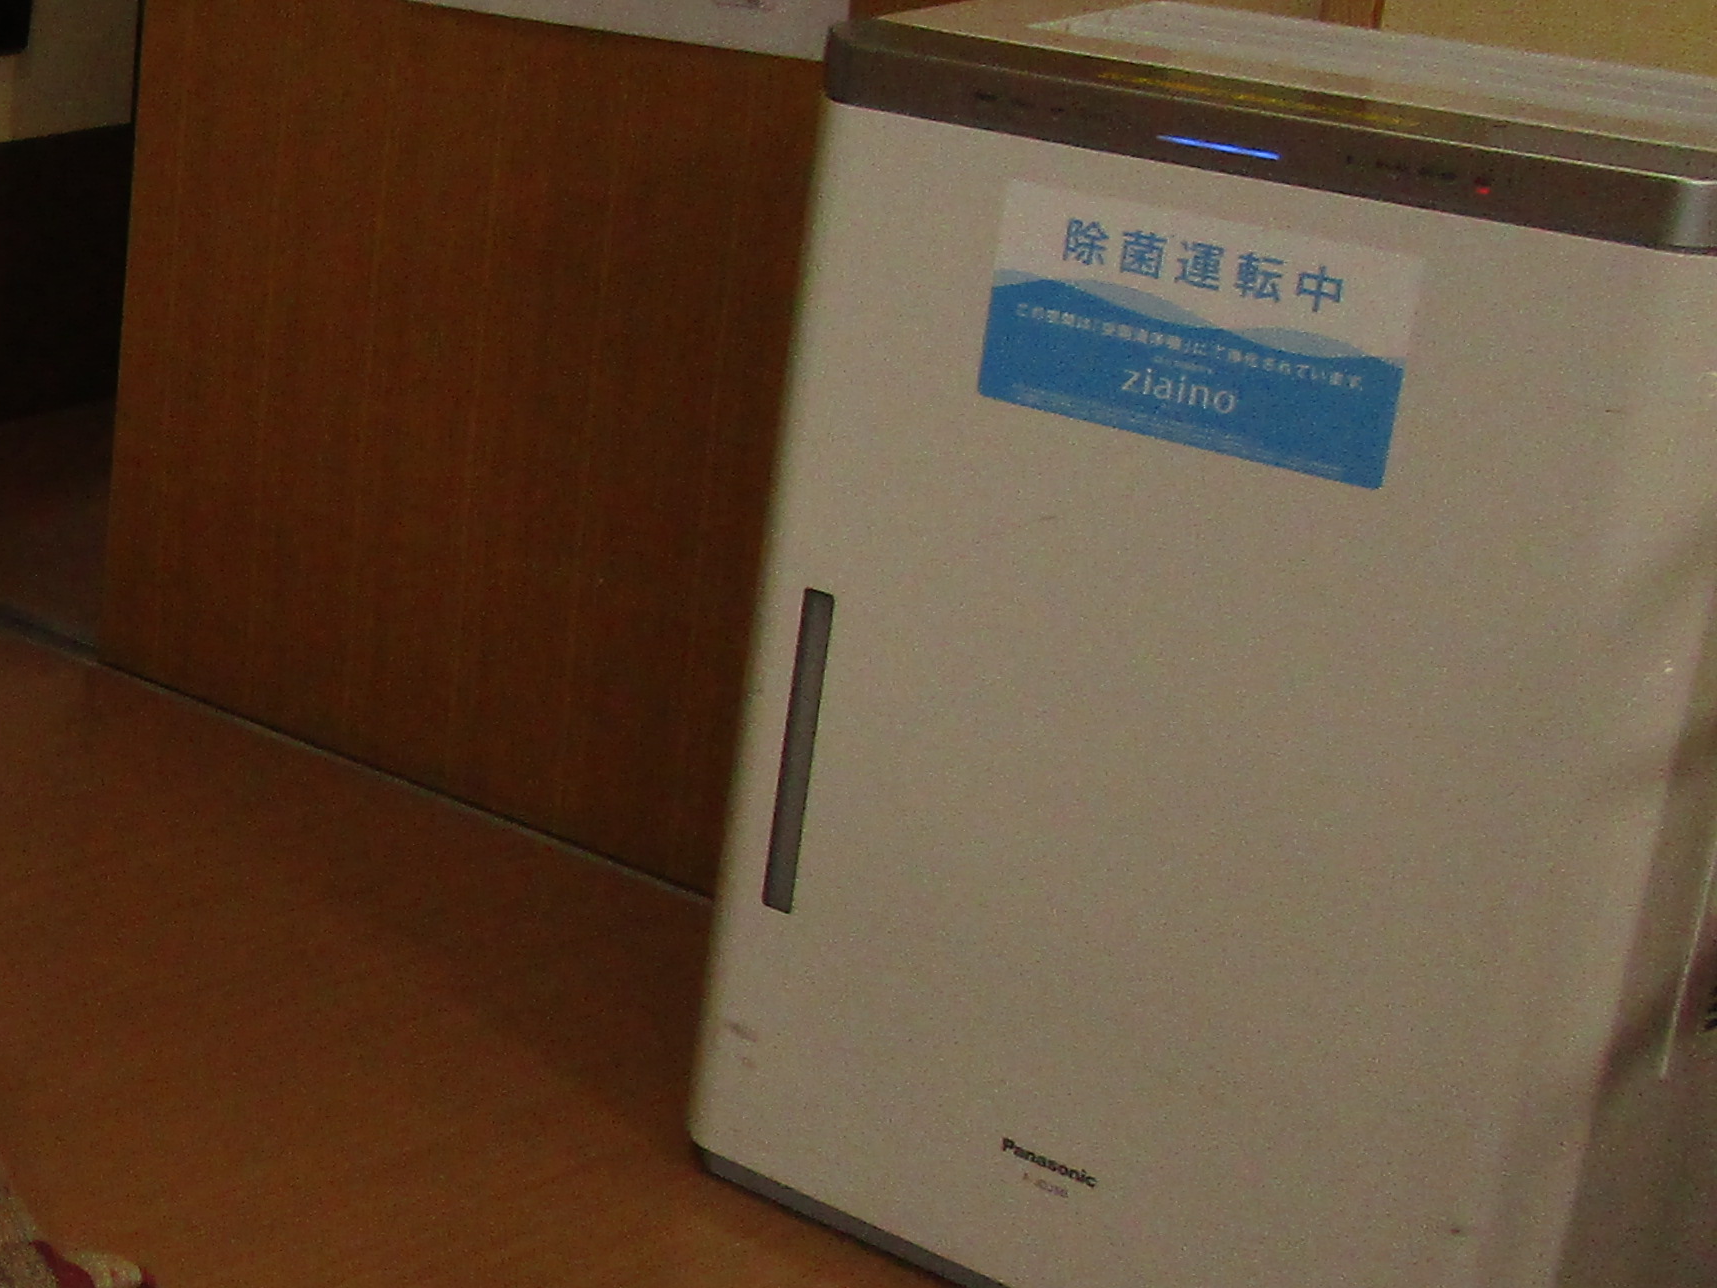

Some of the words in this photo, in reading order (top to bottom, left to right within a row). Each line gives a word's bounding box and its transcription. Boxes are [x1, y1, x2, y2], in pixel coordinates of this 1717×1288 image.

[1062, 216, 1345, 313] 除菌運転中
[1120, 365, 1239, 414] ziaino
[1001, 1136, 1099, 1189] Panasonic
